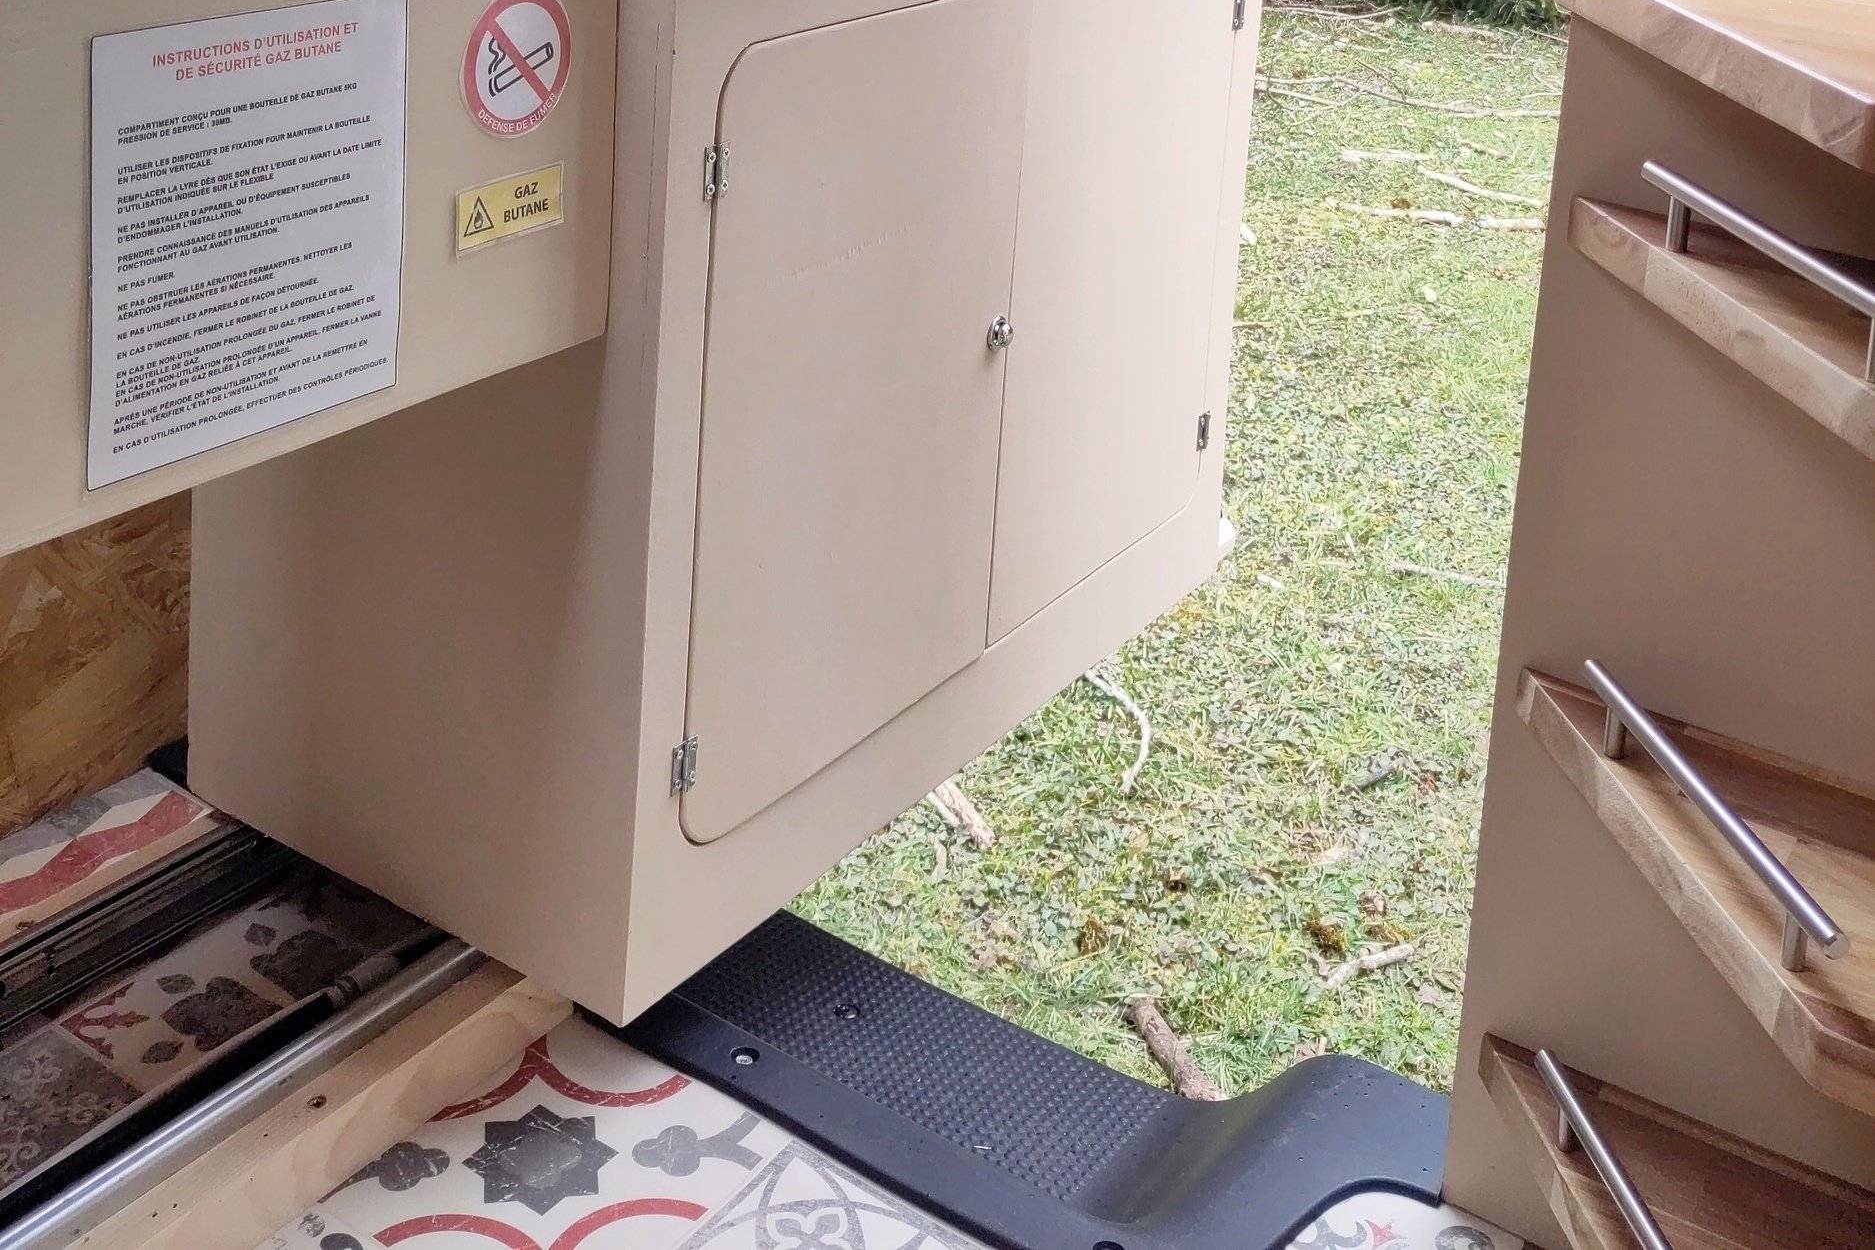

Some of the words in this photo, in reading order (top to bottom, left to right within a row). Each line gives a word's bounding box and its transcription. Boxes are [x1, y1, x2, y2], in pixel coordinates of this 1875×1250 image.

[153, 39, 249, 67] INSTRUCTIONS
[254, 25, 339, 49] D'UTILISATION
[344, 21, 358, 34] ET
[176, 66, 193, 81] DE
[198, 52, 261, 77] SÉCURITÉ
[266, 49, 290, 64] GAZ
[295, 41, 341, 59] BUTANE
[118, 116, 178, 136] COMPARTIMENT
[182, 111, 208, 125] CONÇU
[210, 106, 230, 118] POUR
[233, 103, 247, 113] UNE
[249, 95, 288, 110] BOUTEILLE
[290, 93, 298, 102] DE
[301, 90, 314, 100] GAZ
[316, 85, 342, 97] BUTANE
[118, 131, 157, 145] PRESSION
[160, 128, 170, 137] DE
[172, 121, 204, 134] SERVICE
[478, 108, 514, 133] DEFENSE
[516, 119, 528, 130] DE
[530, 93, 556, 125] FUMER
[118, 161, 152, 175] UTILISER
[155, 157, 169, 167] LES
[172, 147, 217, 163] DISPOSITIFS
[220, 144, 229, 153] DE
[231, 137, 263, 151] FIXATION
[266, 133, 285, 143] POUR
[287, 125, 323, 139] MAINTENIR
[325, 122, 333, 131] LA
[335, 115, 370, 129] BOUTEILLE
[117, 195, 172, 215] D'UTILISATION
[175, 184, 210, 202] INDIQUÉE
[213, 182, 227, 193] SUR
[229, 180, 238, 189] LE
[240, 171, 273, 186] FLEXIBLE
[118, 187, 165, 205] REMPLACER
[168, 184, 177, 193] LA
[180, 180, 198, 191] LYRE
[218, 172, 232, 183] QUE
[235, 168, 249, 178] SON
[252, 162, 268, 174] ÉTAT
[298, 155, 308, 164] OU
[310, 150, 330, 161] AVANT
[333, 148, 341, 156] LA
[343, 144, 359, 154] DATE
[361, 138, 381, 149] LIMITE
[118, 176, 128, 185] EN
[131, 167, 167, 182] POSITION
[514, 181, 538, 199] GAZ
[117, 224, 128, 235] NE
[130, 220, 145, 232] PAS
[148, 210, 189, 228] INSTALLER
[191, 199, 234, 217] D'APPAREIL
[236, 196, 246, 206] OU
[248, 182, 299, 204] D'ÉQUIPEMENT
[302, 172, 350, 191] SUSCEPTIBLES
[503, 198, 549, 223] BUTANE
[117, 222, 181, 244] D'ENDOMMAGER
[117, 251, 176, 273] FONCTIONNANT
[180, 248, 190, 257] AU
[192, 243, 207, 254] GAZ
[209, 237, 232, 249] AVANT
[234, 225, 279, 243] UTILISATION.
[118, 247, 154, 263] PRENDRE
[157, 232, 216, 253] CONNAISSANCE
[218, 228, 232, 238] DES
[234, 219, 268, 234] MANUELS
[270, 206, 318, 225] D'UTILISATION
[320, 203, 332, 212] DES
[334, 194, 369, 209] APPAREILS
[117, 302, 127, 311] NE
[130, 297, 145, 308] PAS
[148, 286, 188, 303] OBSTRUER
[190, 281, 204, 292] LES
[207, 268, 247, 287] AÉRATIONS
[304, 245, 338, 261] NETTOYER
[340, 241, 352, 251] LES
[117, 282, 128, 292] NE
[130, 278, 145, 289] PAS
[117, 330, 127, 341] NE
[130, 325, 144, 337] PAS
[147, 315, 180, 332] UTILISER
[182, 311, 196, 322] LES
[198, 299, 238, 317] APPAREILS
[240, 296, 249, 306] DE
[251, 289, 275, 304] FAÇON
[117, 349, 127, 359] EN
[130, 344, 145, 355] CAS
[194, 321, 223, 337] FERMER
[225, 318, 234, 327] LE
[236, 309, 267, 324] ROBINET
[269, 305, 278, 315] DE
[280, 302, 288, 311] LA
[290, 291, 326, 308] BOUTEILLE
[328, 288, 337, 297] DE
[118, 301, 161, 321] AÉRATIONS
[163, 287, 218, 309] PERMANENTES
[220, 284, 227, 293] SI
[116, 368, 126, 378] EN
[129, 363, 144, 374] CAS
[147, 359, 156, 369] DE
[159, 340, 221, 365] NON-UTILISATION
[269, 323, 278, 332] DU
[298, 309, 325, 323] FERMER
[327, 306, 335, 315] LE
[337, 297, 364, 312] ROBINET
[366, 294, 375, 303] DE
[115, 380, 177, 406] D'ALIMENTATION
[179, 377, 189, 386] EN
[191, 371, 206, 382] GAZ
[242, 356, 255, 366] CET
[116, 378, 125, 387] LA
[128, 365, 169, 384] BOUTEILLE
[172, 361, 181, 370] DE
[187, 395, 209, 411] L'ÉTAT
[212, 393, 221, 403] DE
